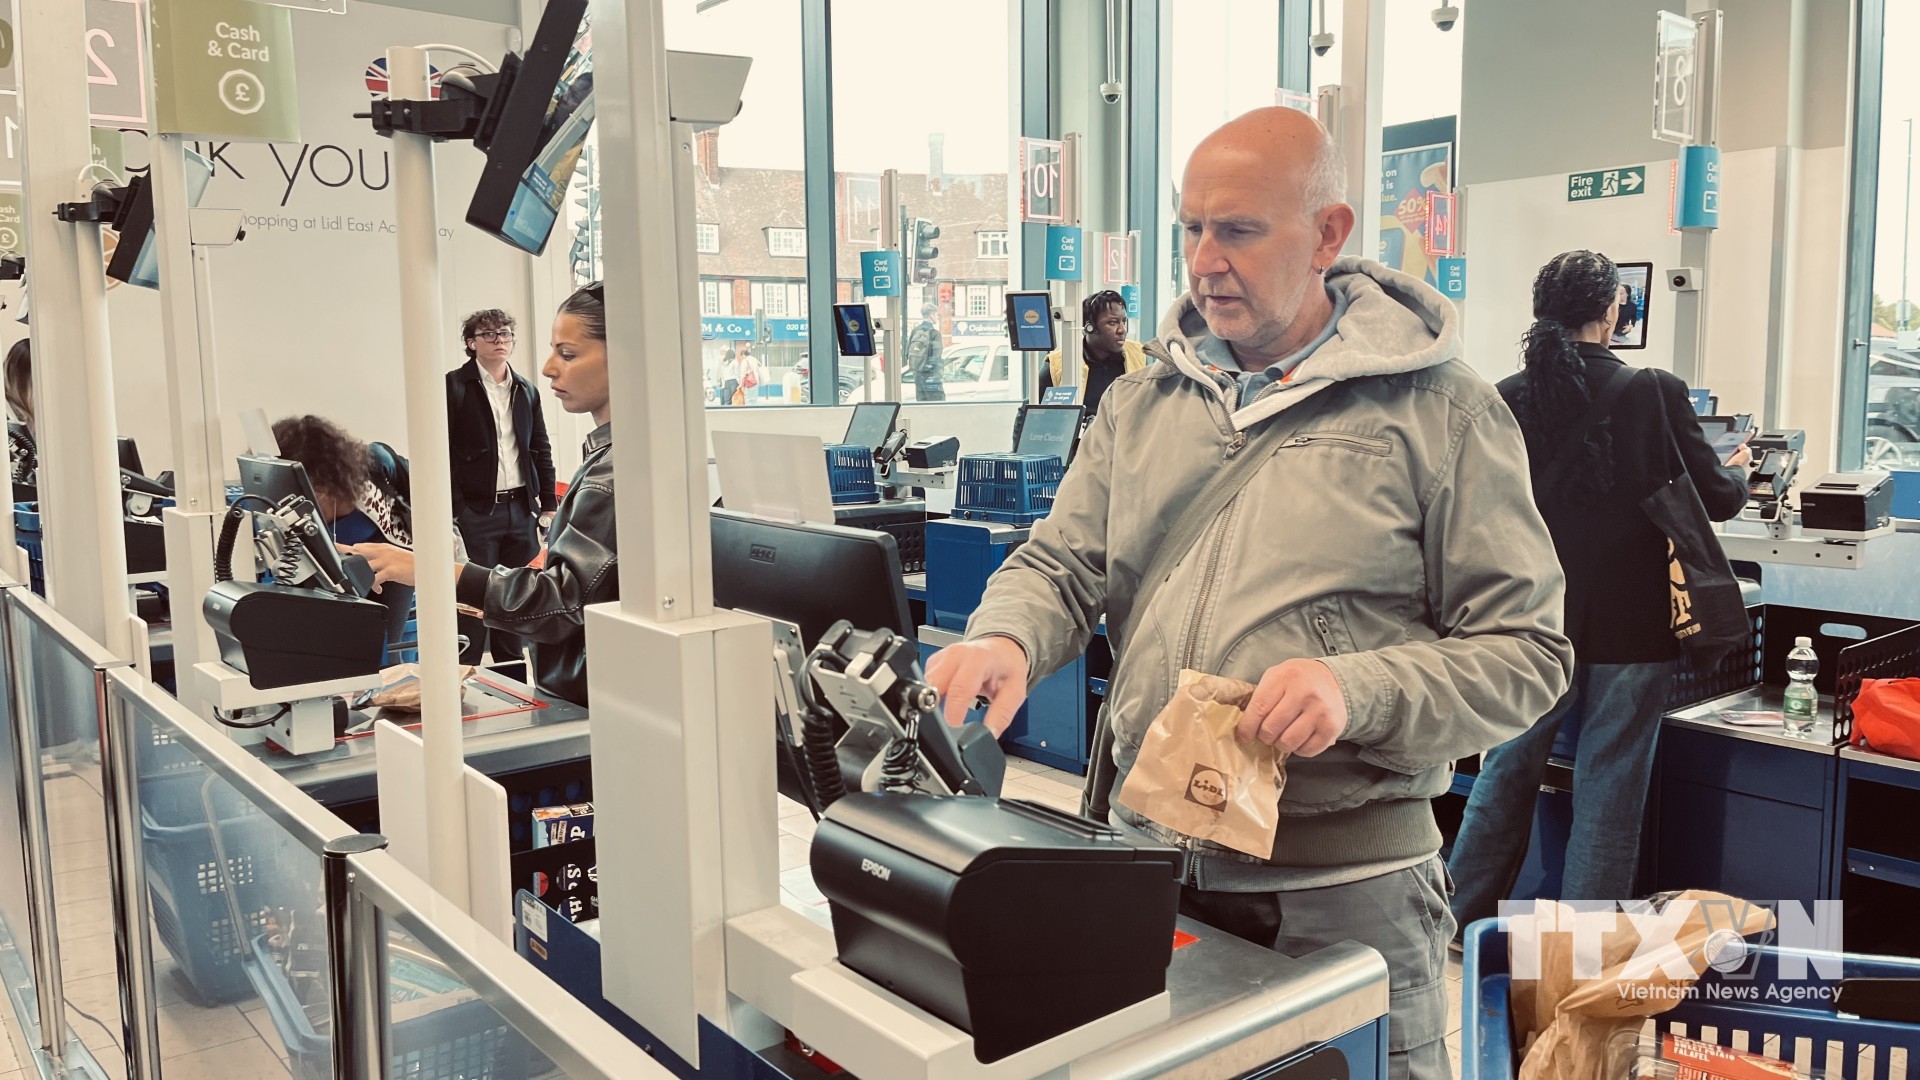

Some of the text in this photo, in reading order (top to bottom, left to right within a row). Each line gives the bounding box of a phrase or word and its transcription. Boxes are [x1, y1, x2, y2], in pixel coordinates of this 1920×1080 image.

[215, 22, 261, 42] Cash
[207, 40, 270, 62] & Card
[1673, 55, 1687, 106] 8
[268, 143, 389, 206] you
[1571, 176, 1594, 188] Fire
[1570, 186, 1592, 198] exit
[0, 205, 15, 214] ash
[303, 218, 316, 229] at
[321, 216, 342, 230] Lidl
[347, 218, 374, 232] East
[1061, 236, 1075, 244] Card
[1061, 243, 1075, 252] Only
[726, 323, 742, 333] Co
[861, 858, 891, 881] EPSON
[1674, 1046, 1711, 1062] FALAFEL
